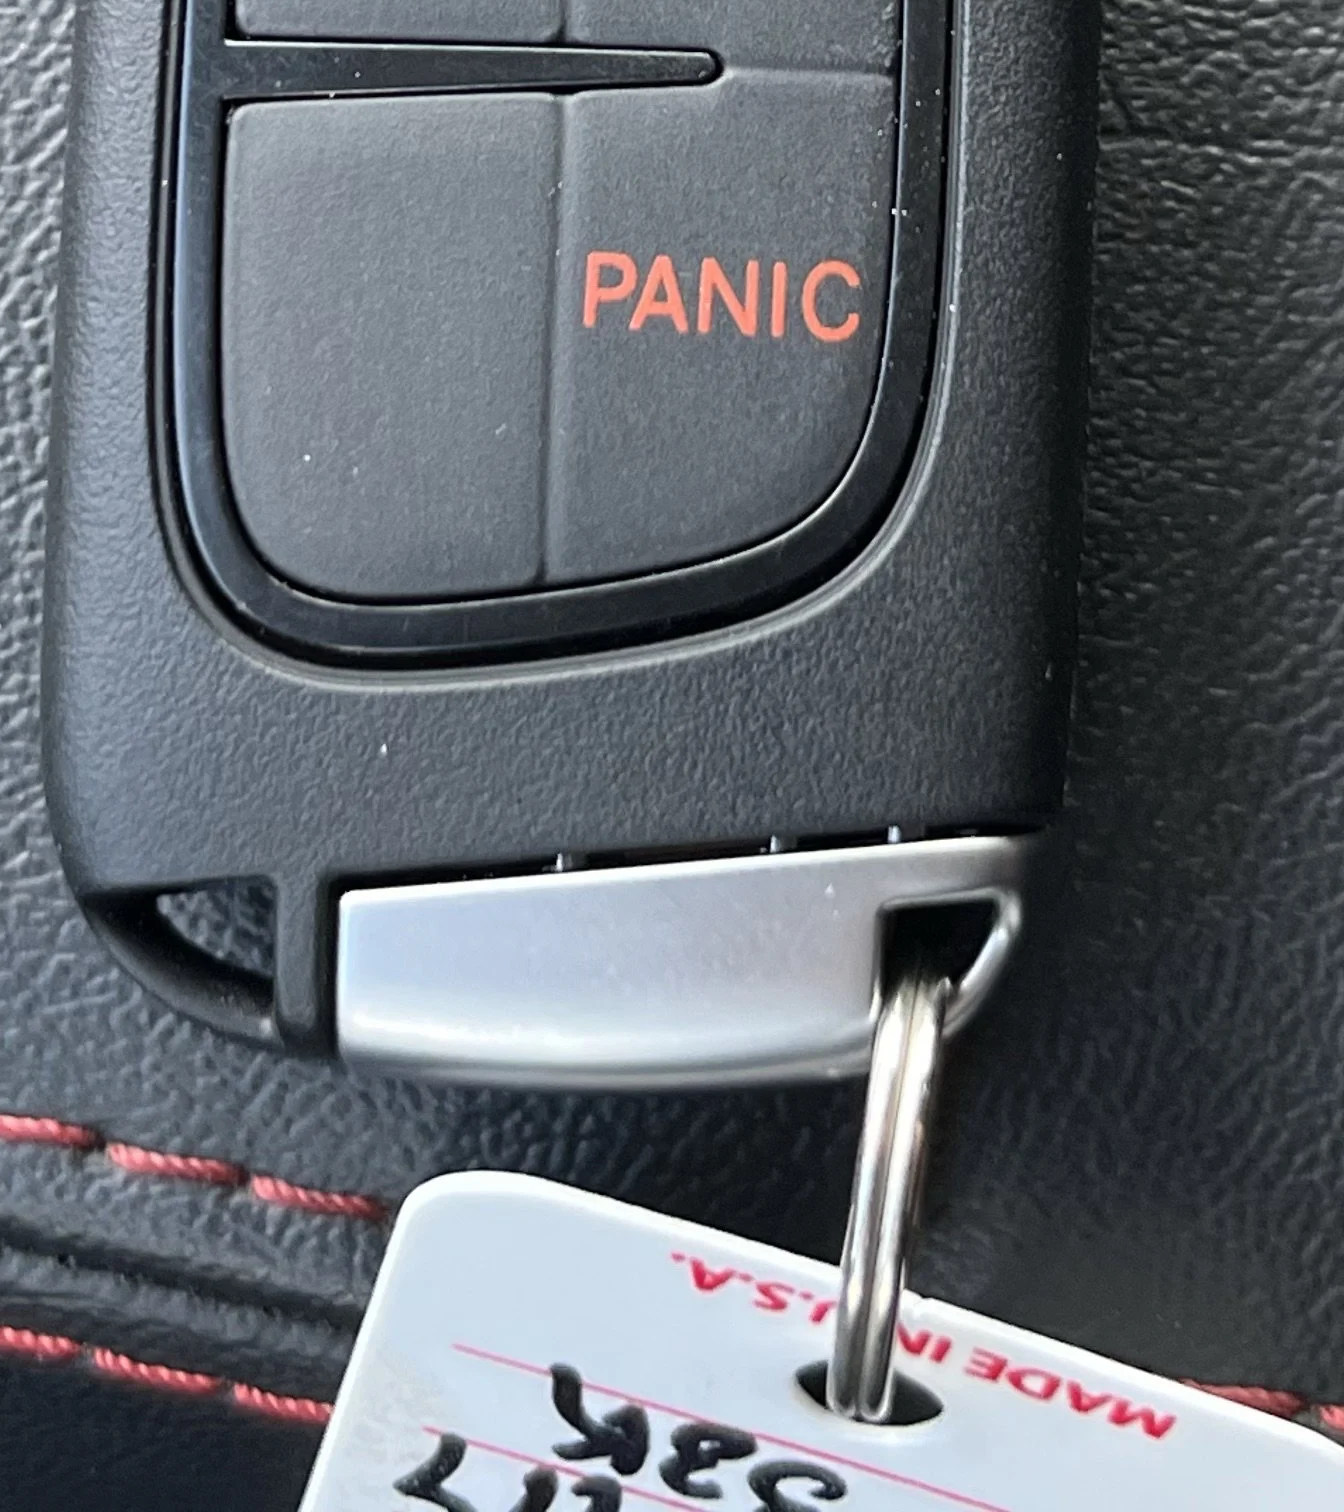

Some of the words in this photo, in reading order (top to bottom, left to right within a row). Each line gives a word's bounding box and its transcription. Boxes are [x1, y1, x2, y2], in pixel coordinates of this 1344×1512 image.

[583, 251, 861, 342] PANIC
[897, 1326, 953, 1363] IN
[965, 1347, 1177, 1439] MADE
